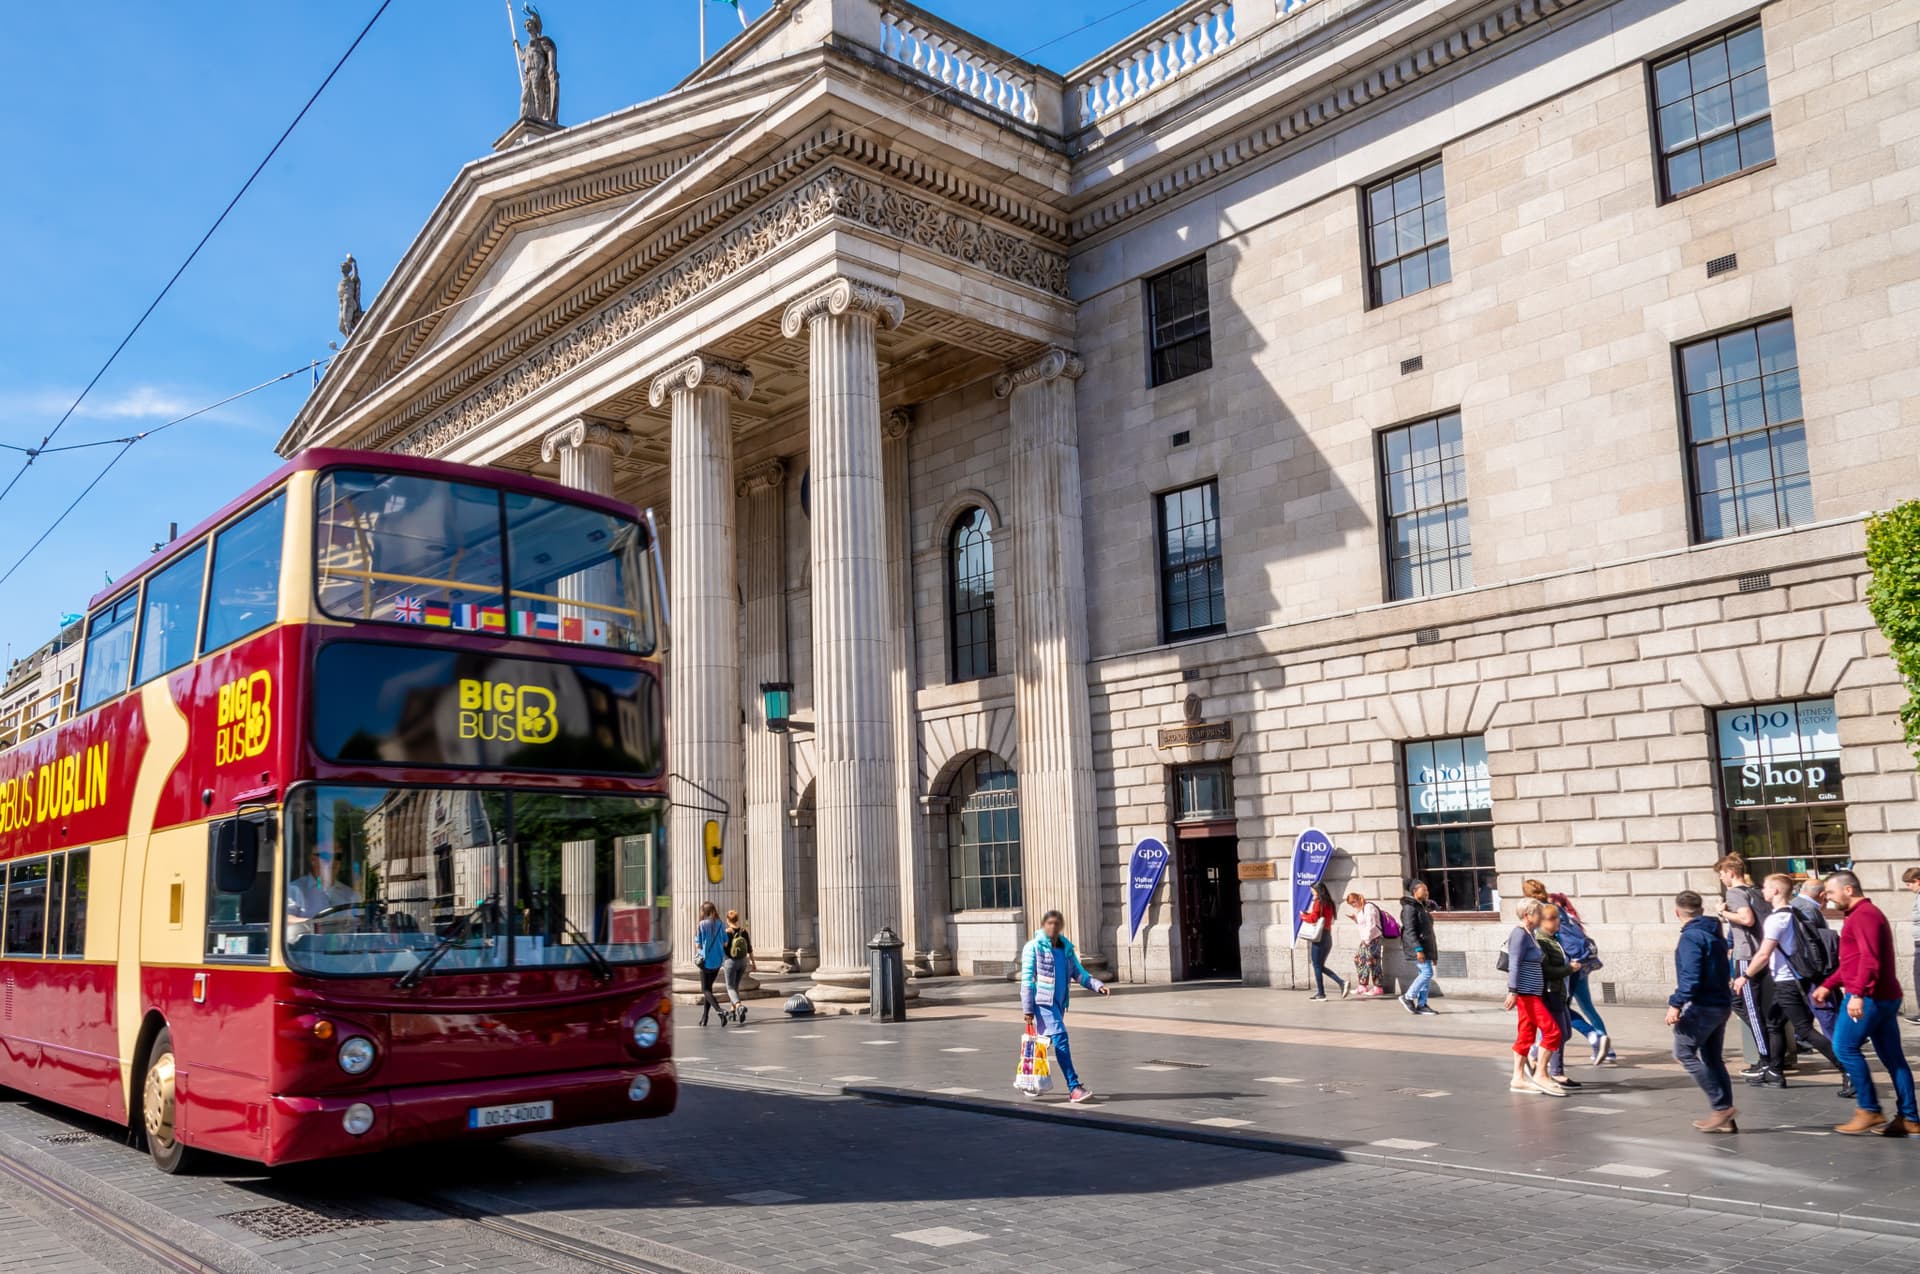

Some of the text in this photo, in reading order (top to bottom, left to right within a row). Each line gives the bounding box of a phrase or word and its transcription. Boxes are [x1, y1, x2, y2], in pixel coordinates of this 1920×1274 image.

[218, 677, 248, 726] BIG
[459, 678, 515, 712] BIG
[459, 711, 516, 741] BUS
[216, 722, 246, 766] BUS
[37, 740, 109, 823] DUBLIN
[1742, 763, 1826, 788] Shop
[1296, 872, 1317, 880] Visitor
